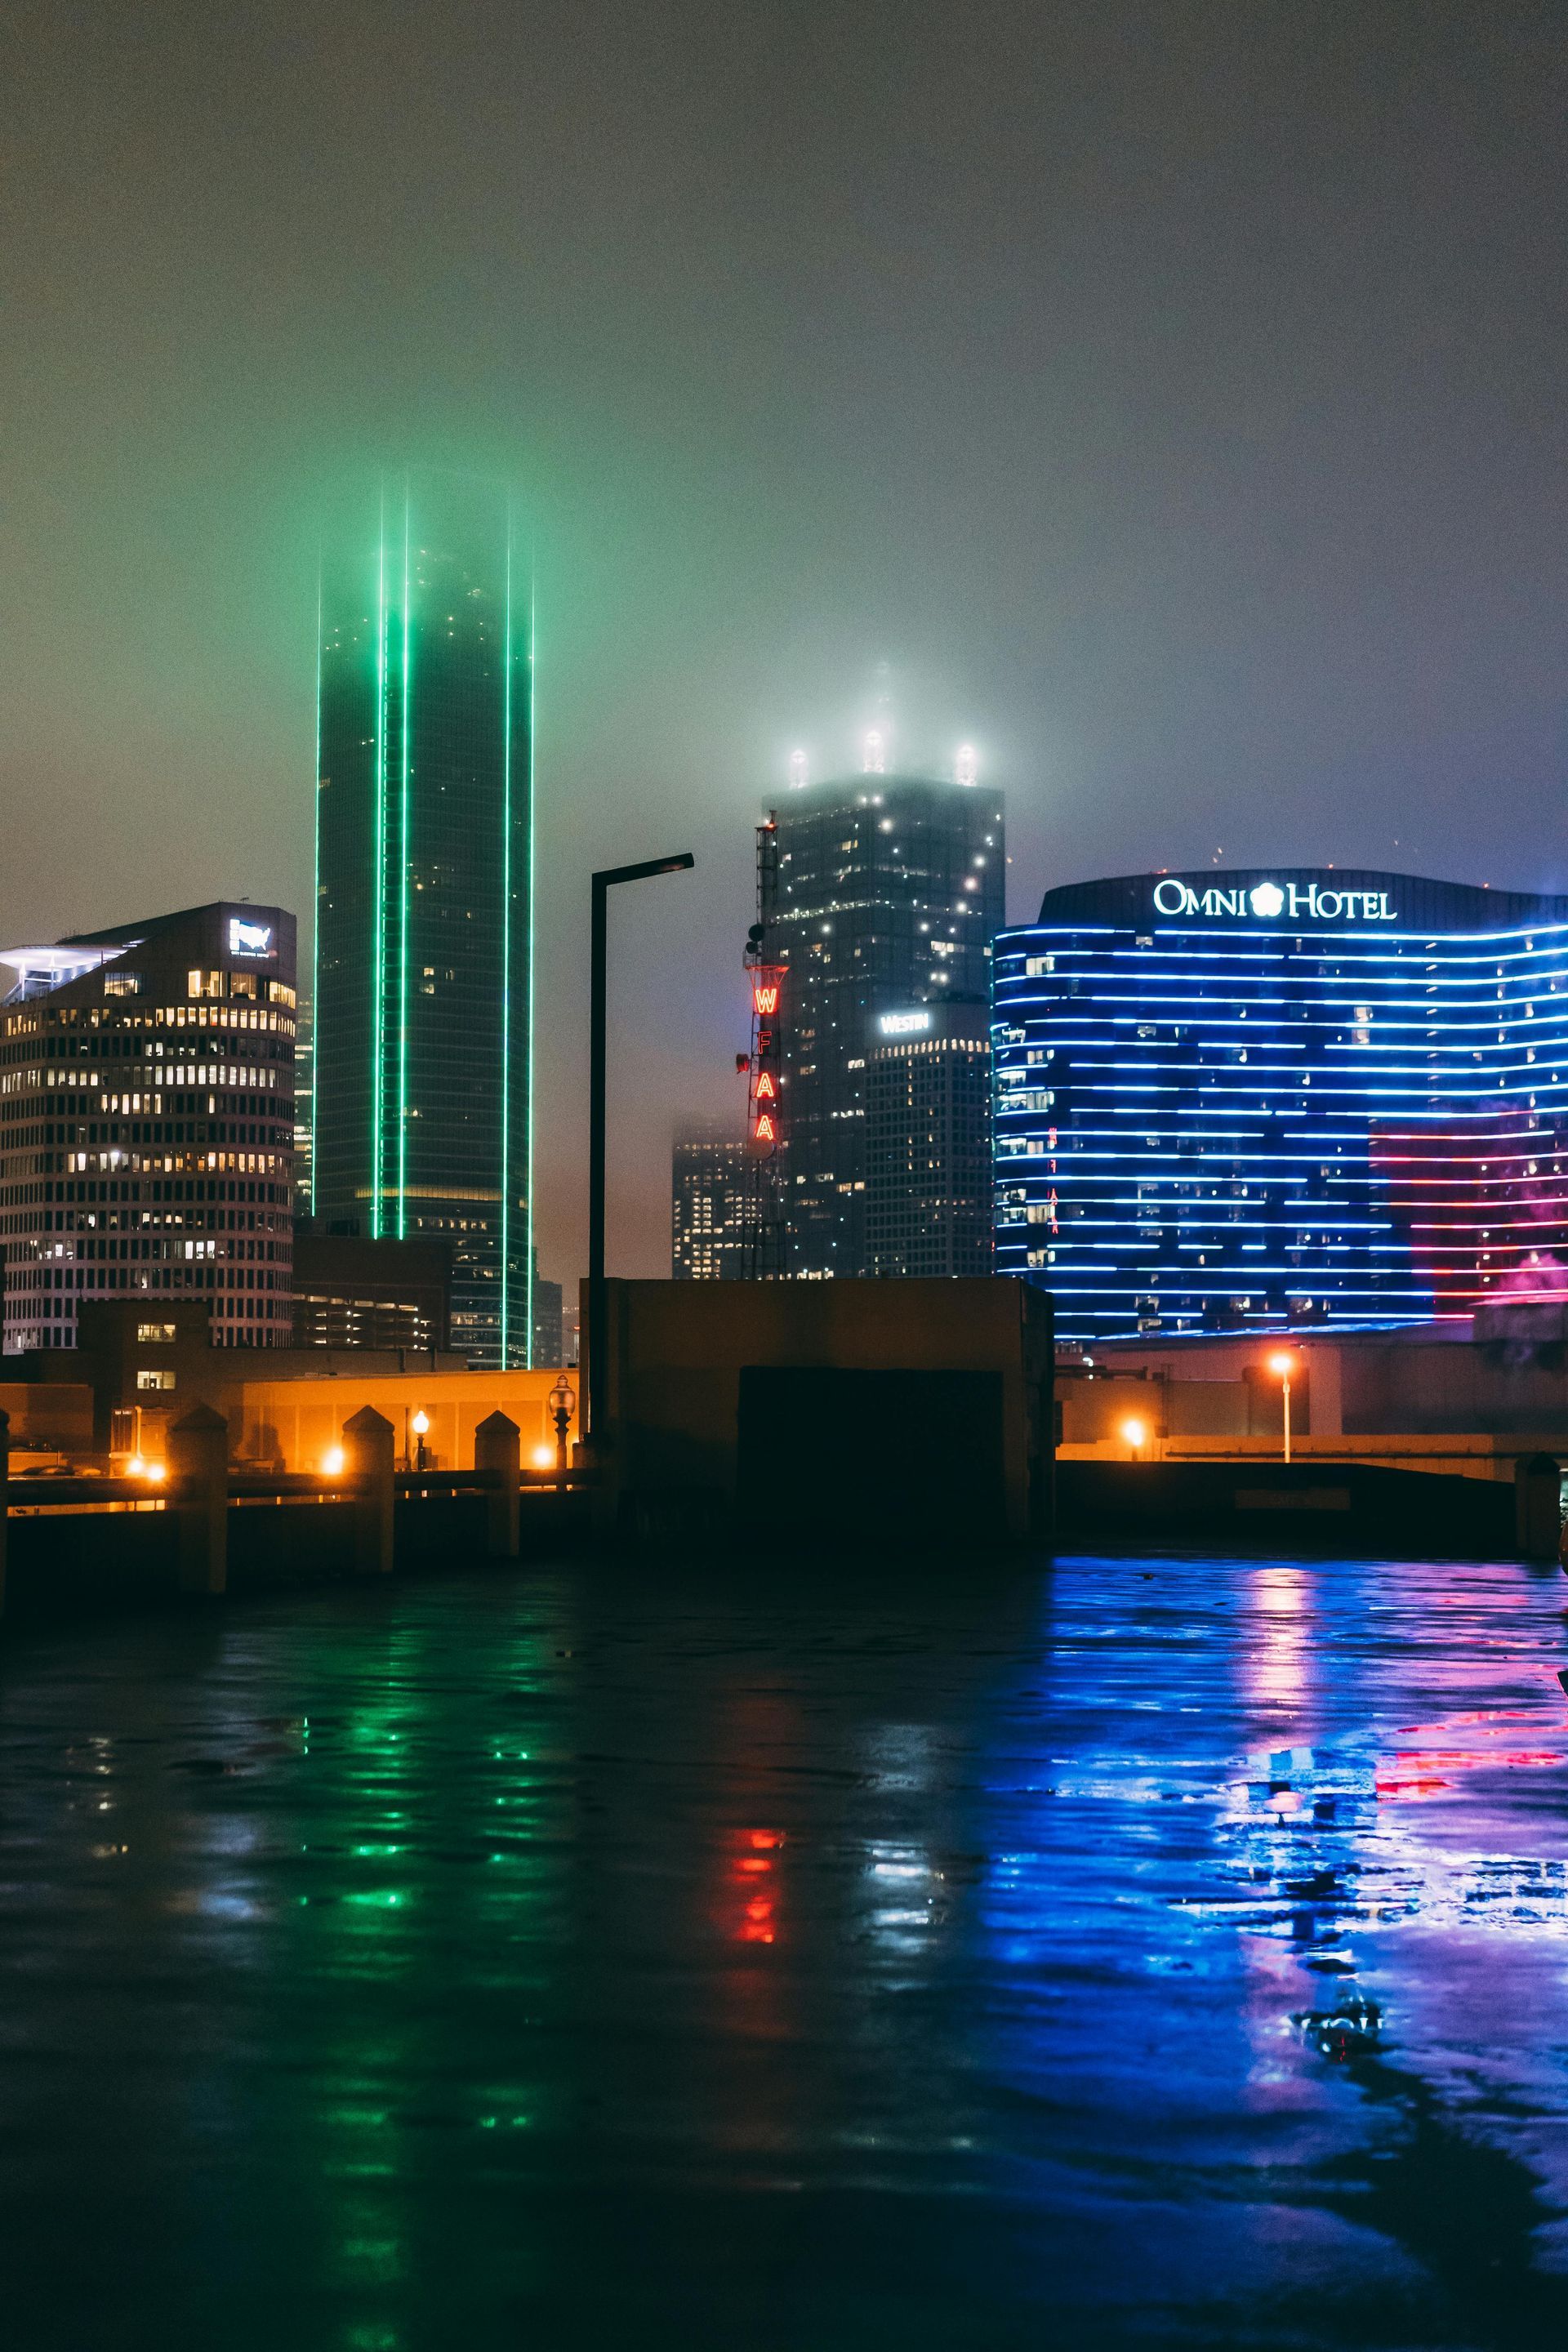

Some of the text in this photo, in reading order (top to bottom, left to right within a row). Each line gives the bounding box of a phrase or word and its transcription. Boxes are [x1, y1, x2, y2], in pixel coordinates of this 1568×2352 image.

[1153, 879, 1397, 920] OMNI HOTEL
[880, 1013, 929, 1034] WESTIN
[755, 988, 777, 1140] WFAA
